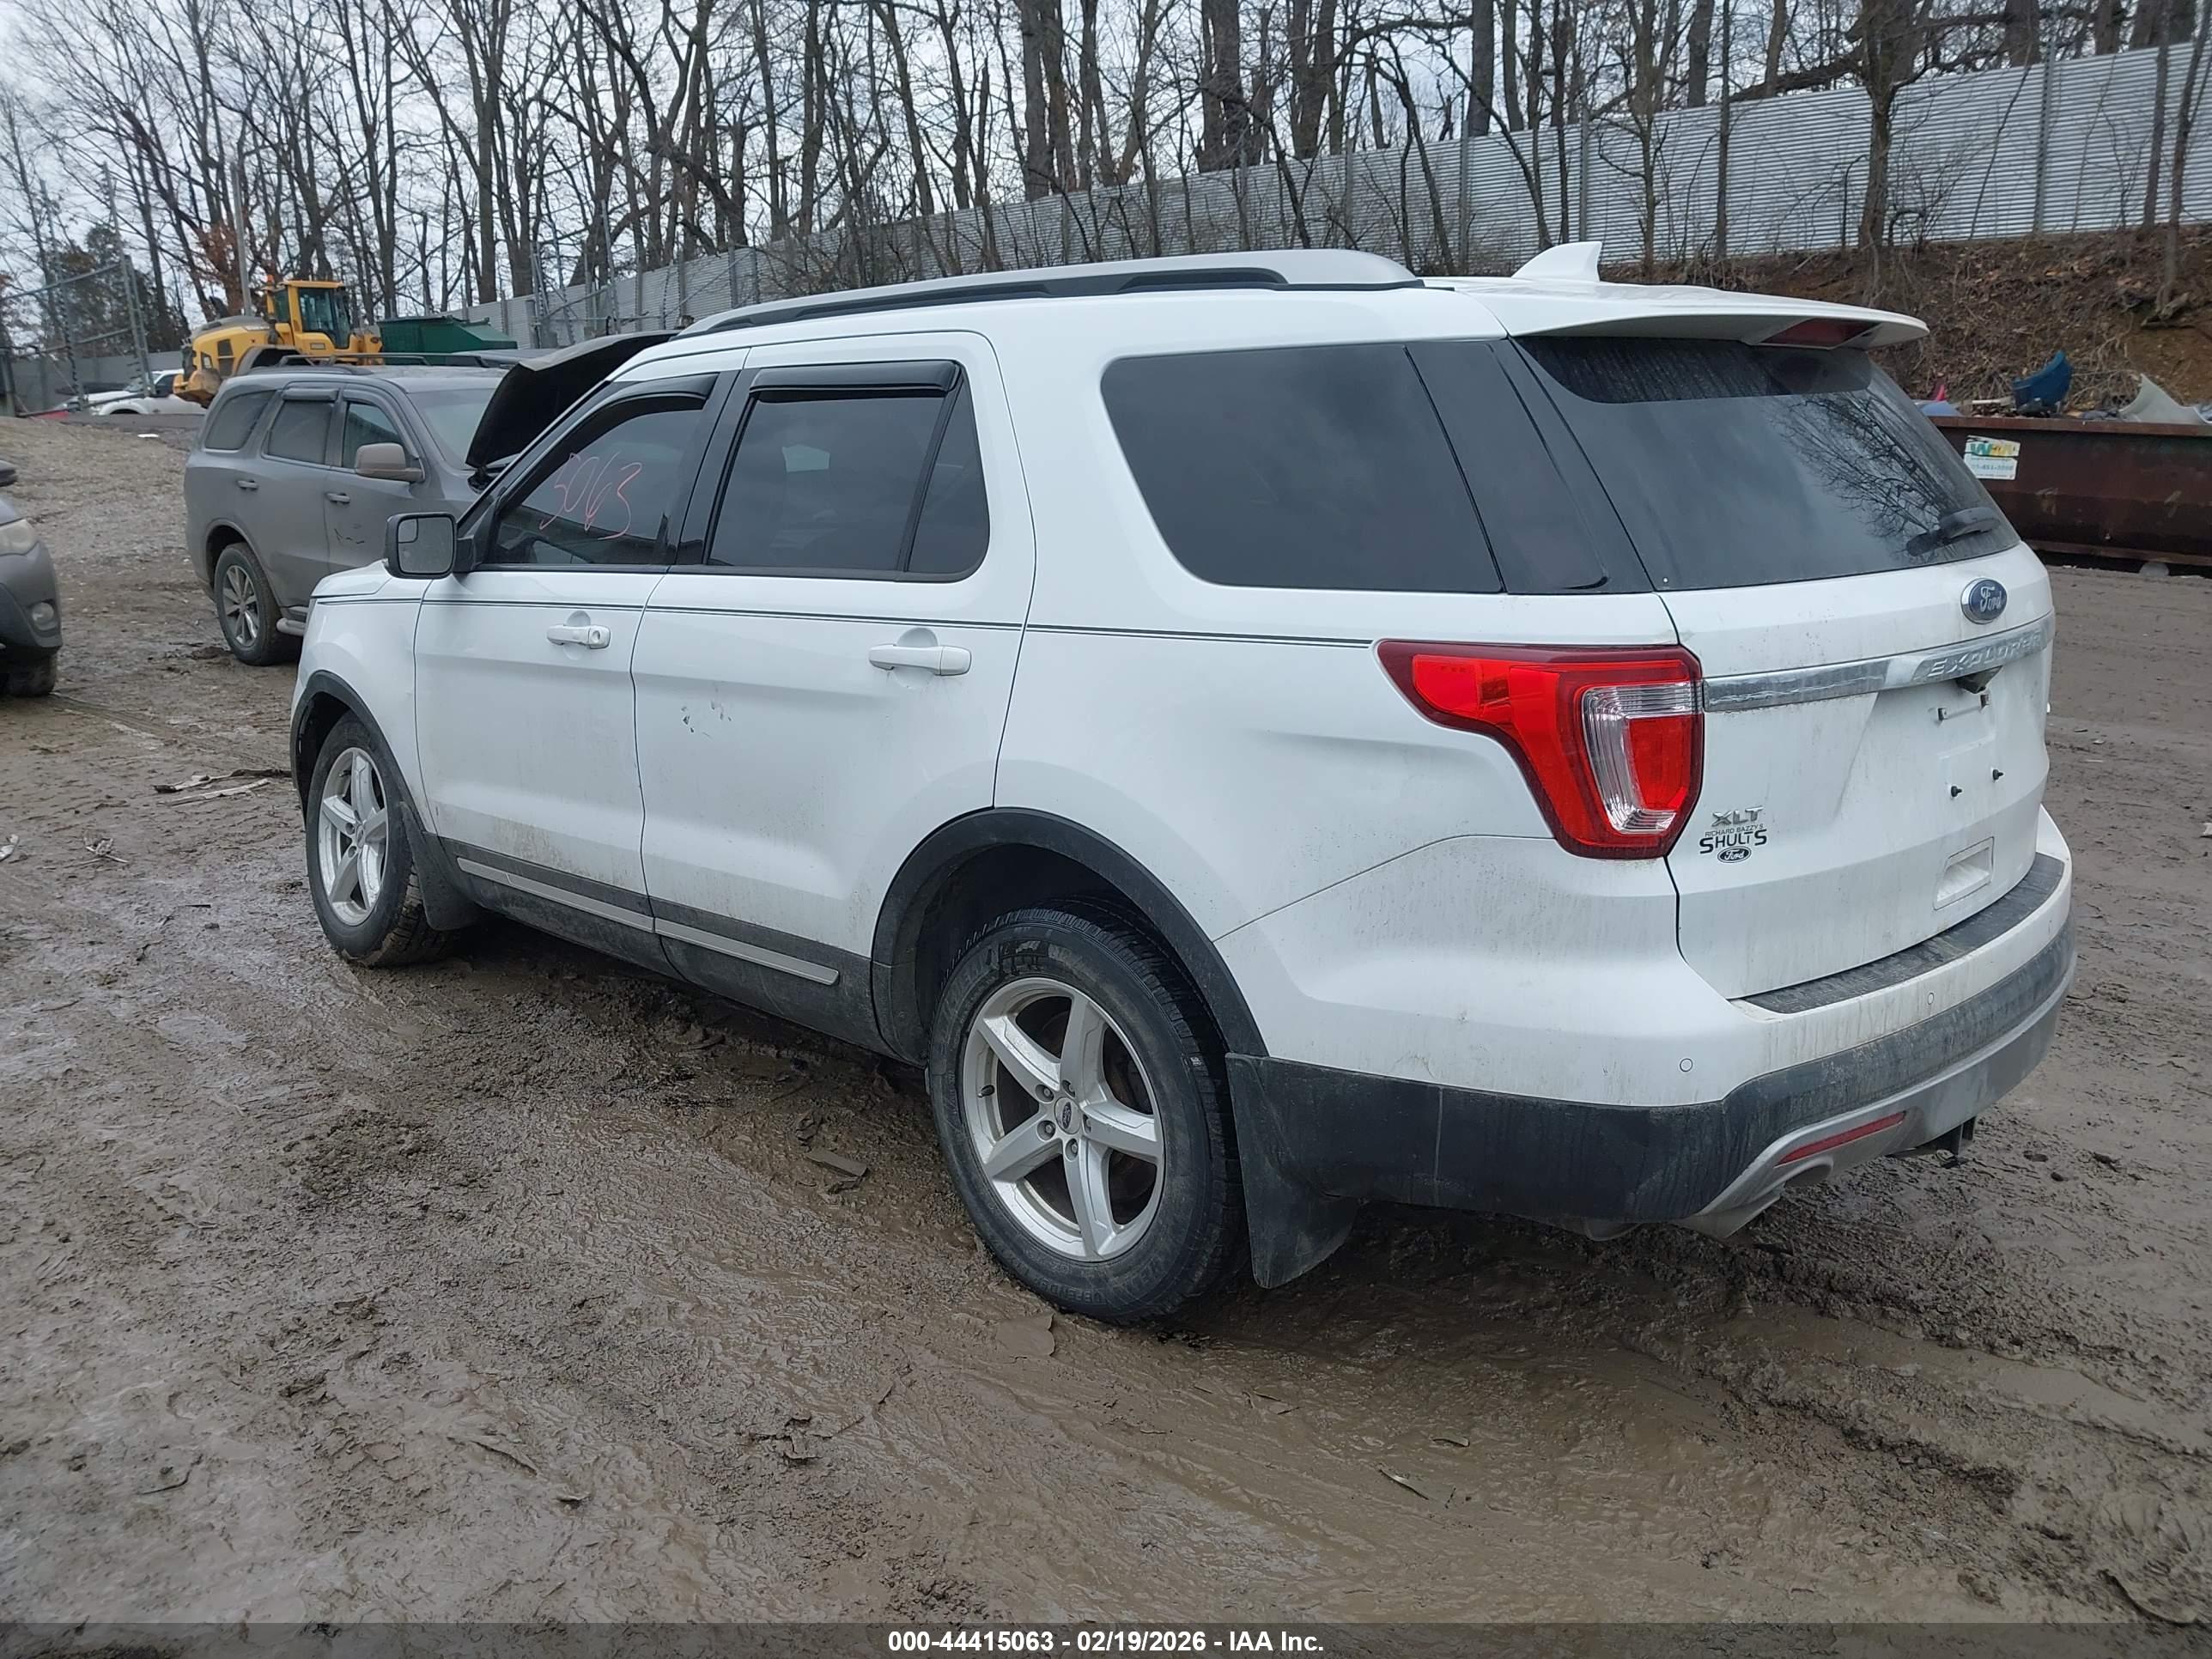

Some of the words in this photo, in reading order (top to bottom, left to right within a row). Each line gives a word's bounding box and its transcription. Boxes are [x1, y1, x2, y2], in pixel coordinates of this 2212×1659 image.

[1711, 805, 1764, 827] XLT
[1699, 829, 1767, 854] SHULTS
[1705, 828, 1735, 837] RICHARD
